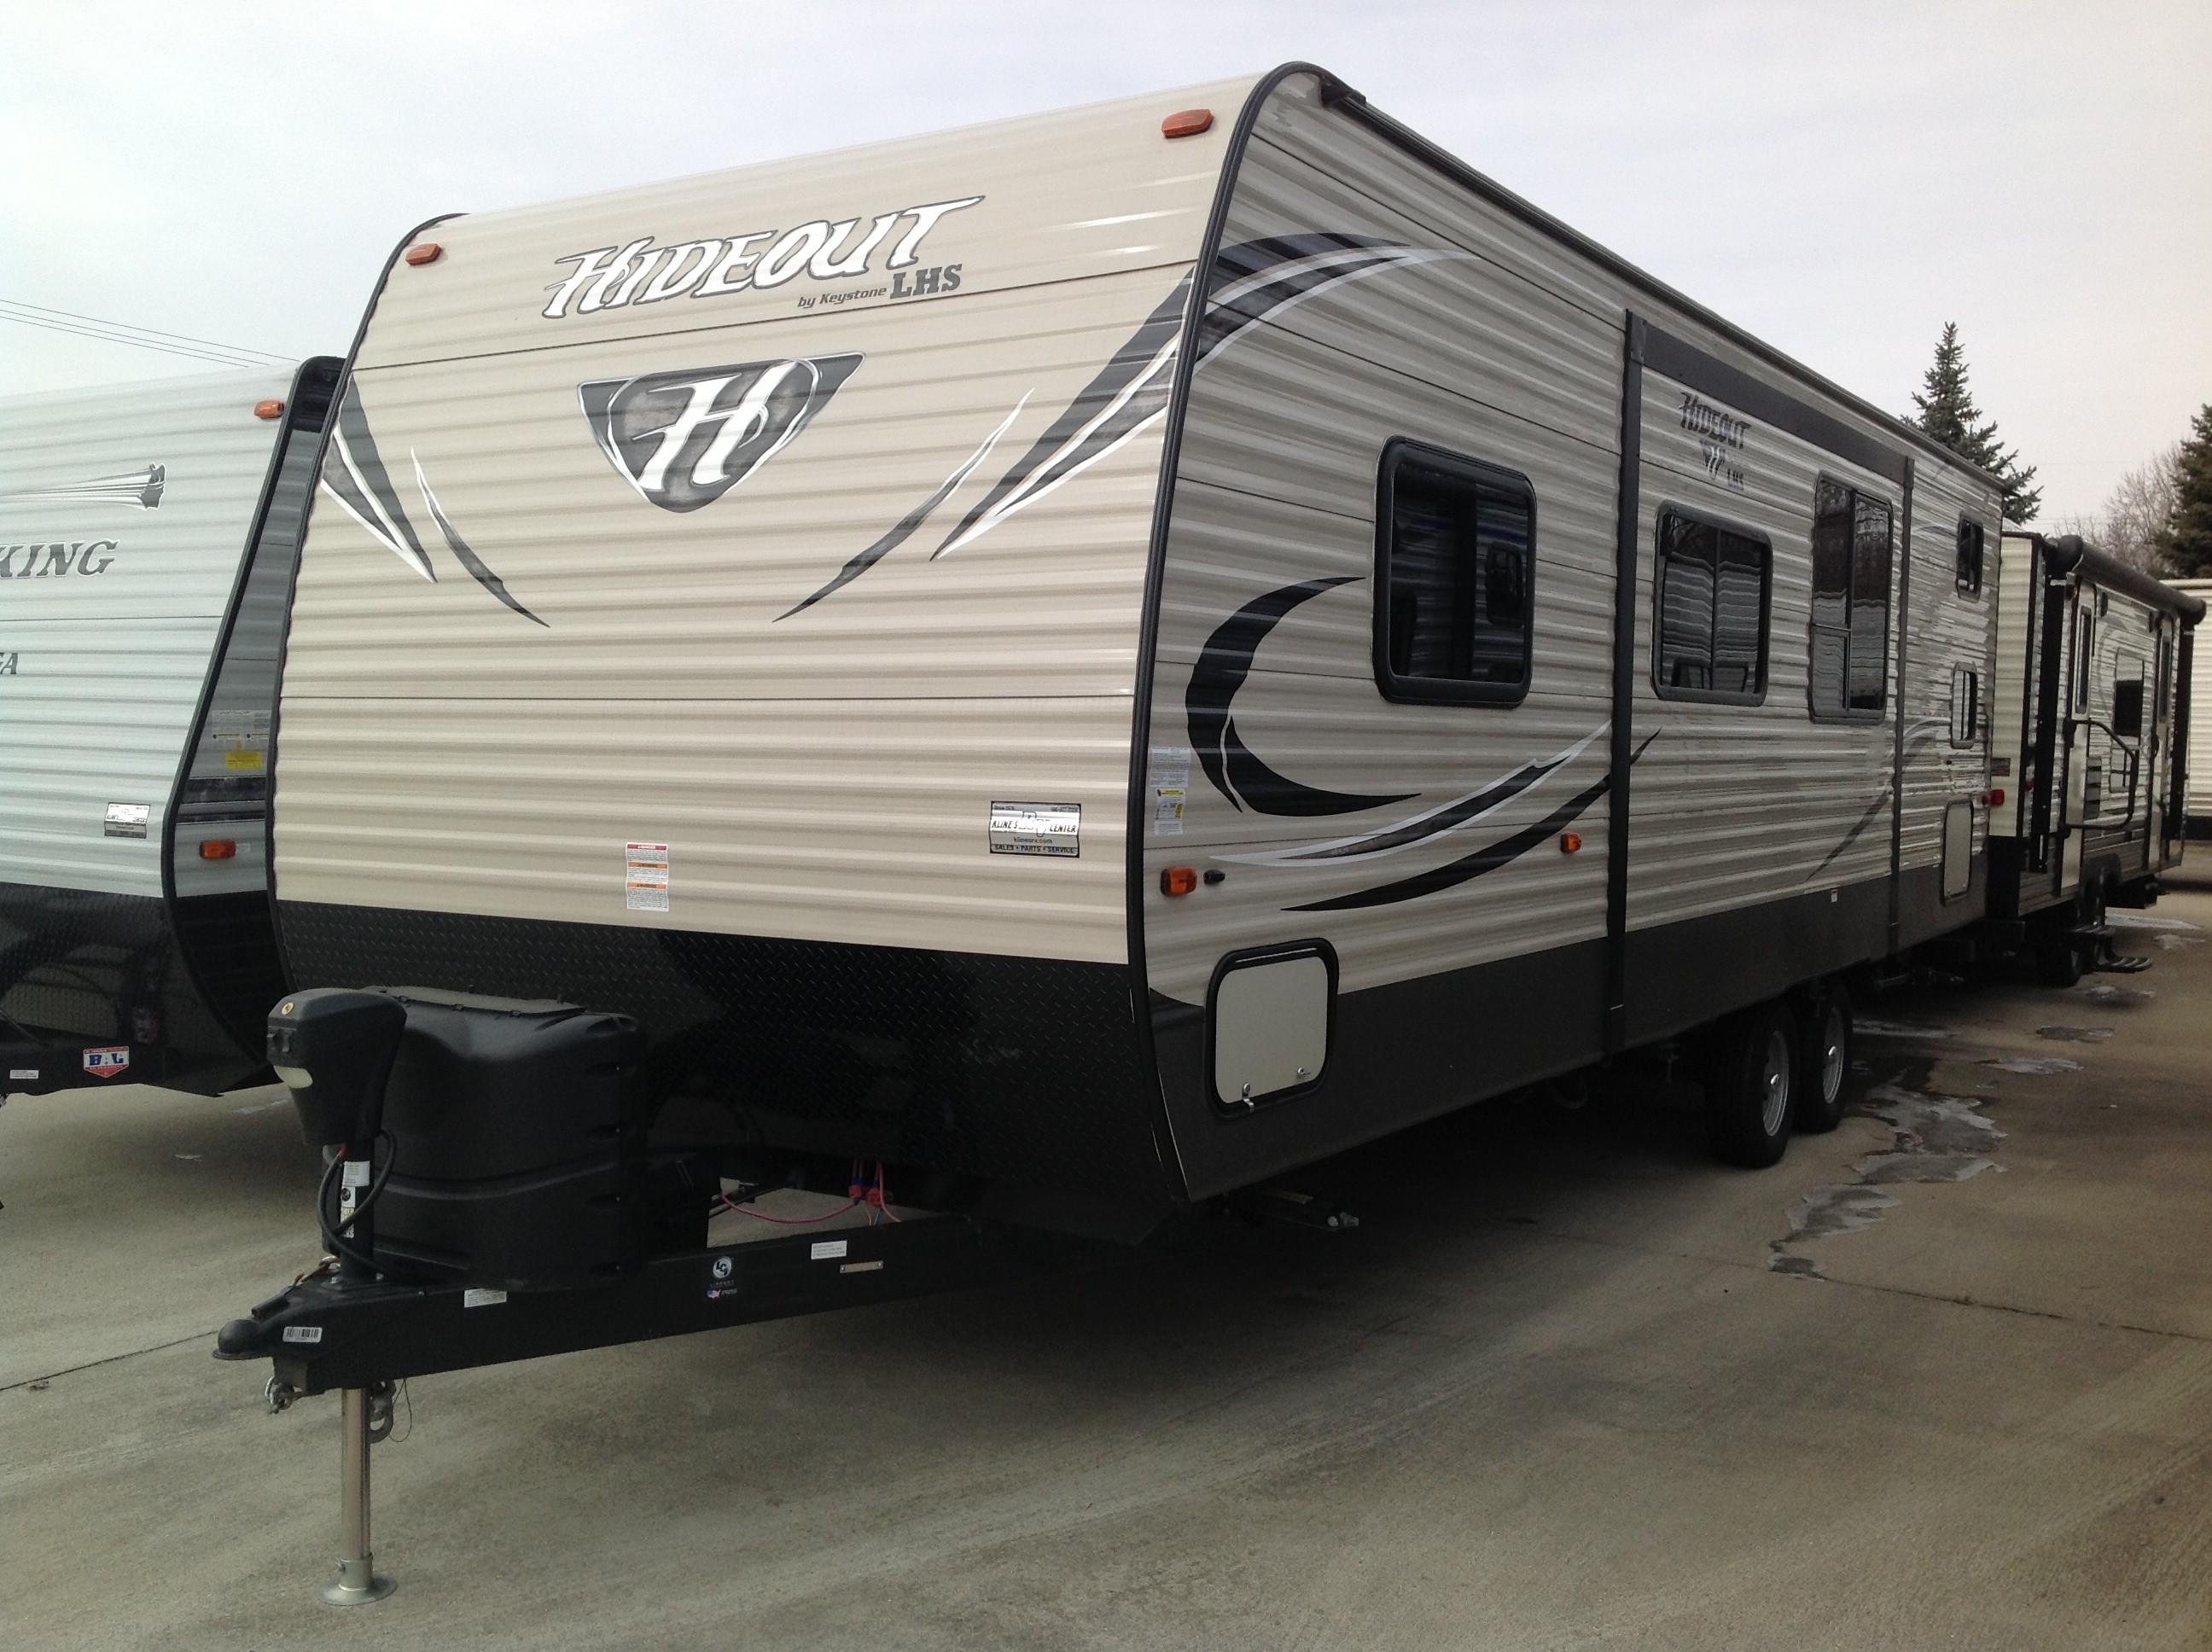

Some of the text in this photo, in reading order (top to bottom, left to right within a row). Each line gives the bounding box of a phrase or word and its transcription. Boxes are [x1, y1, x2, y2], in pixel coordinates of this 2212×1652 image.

[542, 195, 986, 319] HIDEOUT
[797, 264, 963, 309] by Keystone LHS
[1679, 392, 1751, 449] HIDEOUT
[1047, 846, 1075, 854] SERVICE
[89, 1053, 124, 1066] BL
